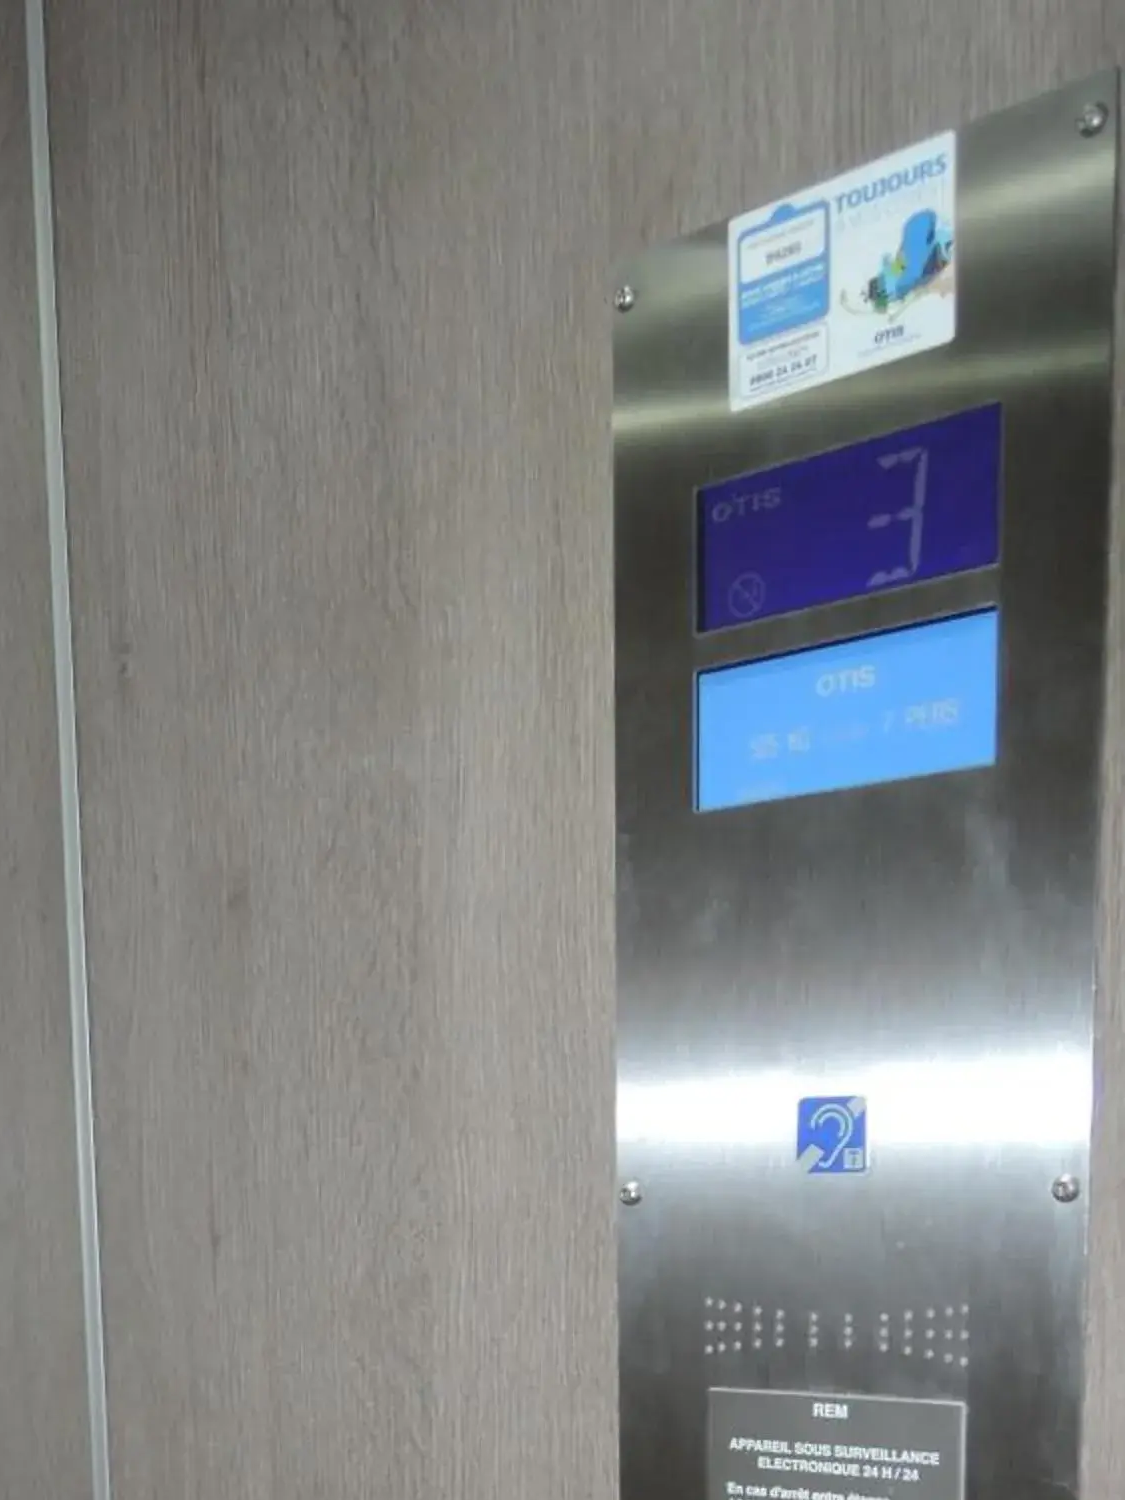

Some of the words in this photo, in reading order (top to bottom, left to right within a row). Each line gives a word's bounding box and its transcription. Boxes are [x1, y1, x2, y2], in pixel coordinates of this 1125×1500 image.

[835, 150, 948, 215] TOUJOURS
[711, 485, 782, 523] OTIS
[866, 446, 929, 588] 3
[815, 665, 876, 697] OTIS
[812, 1402, 849, 1420] REM
[729, 1437, 792, 1456] APPAREIL
[794, 1442, 833, 1457] SOUS
[834, 1445, 941, 1466] SURVEILLANCE
[757, 1456, 861, 1478] ELECTRONIQUE
[862, 1465, 879, 1479] 24
[882, 1467, 893, 1480] H
[902, 1468, 920, 1482] 24
[726, 1481, 744, 1497] En
[746, 1485, 768, 1497] cas
